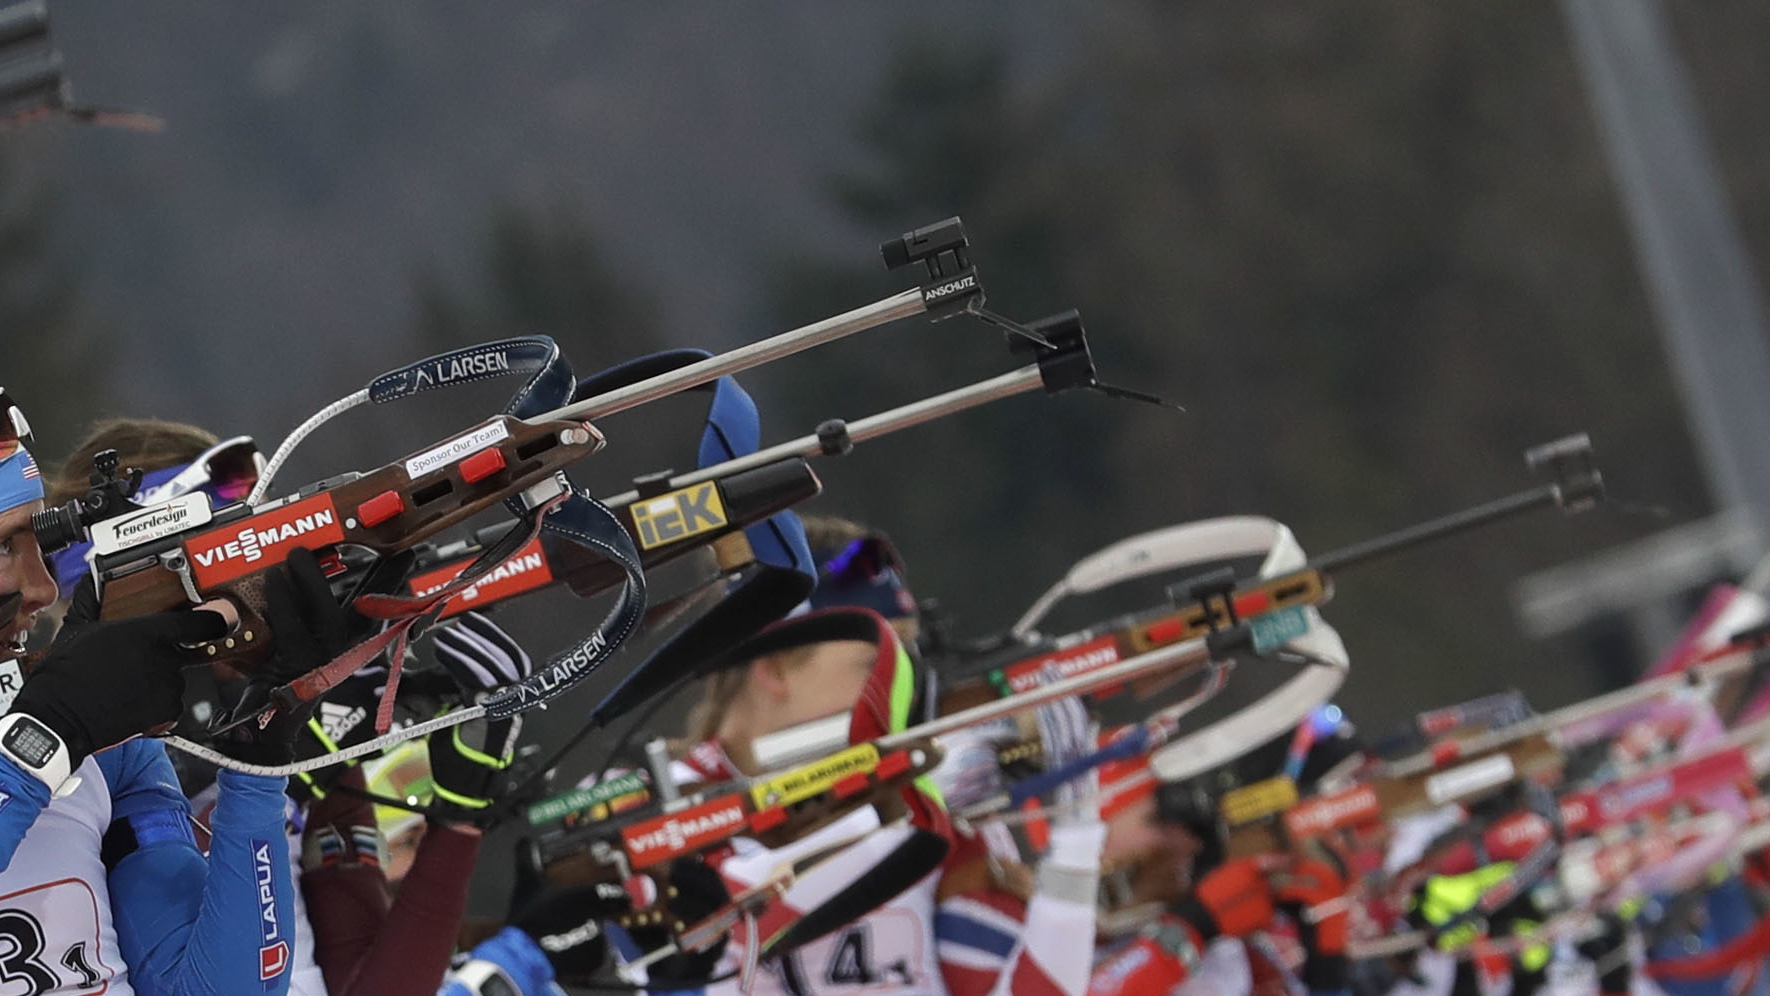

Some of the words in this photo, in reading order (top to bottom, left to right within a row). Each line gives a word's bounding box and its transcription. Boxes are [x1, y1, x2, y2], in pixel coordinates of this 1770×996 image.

[436, 351, 509, 382] LARSEN
[412, 448, 452, 473] Sponsor
[452, 440, 471, 454] Our
[472, 423, 505, 445] Team?
[112, 508, 188, 540] Feuerdesign
[194, 507, 335, 563] VIESSMANN
[538, 629, 608, 692] LARSEN
[627, 807, 744, 852] VIESSMANN
[256, 842, 277, 940] LAPUA
[60, 941, 101, 989] 1
